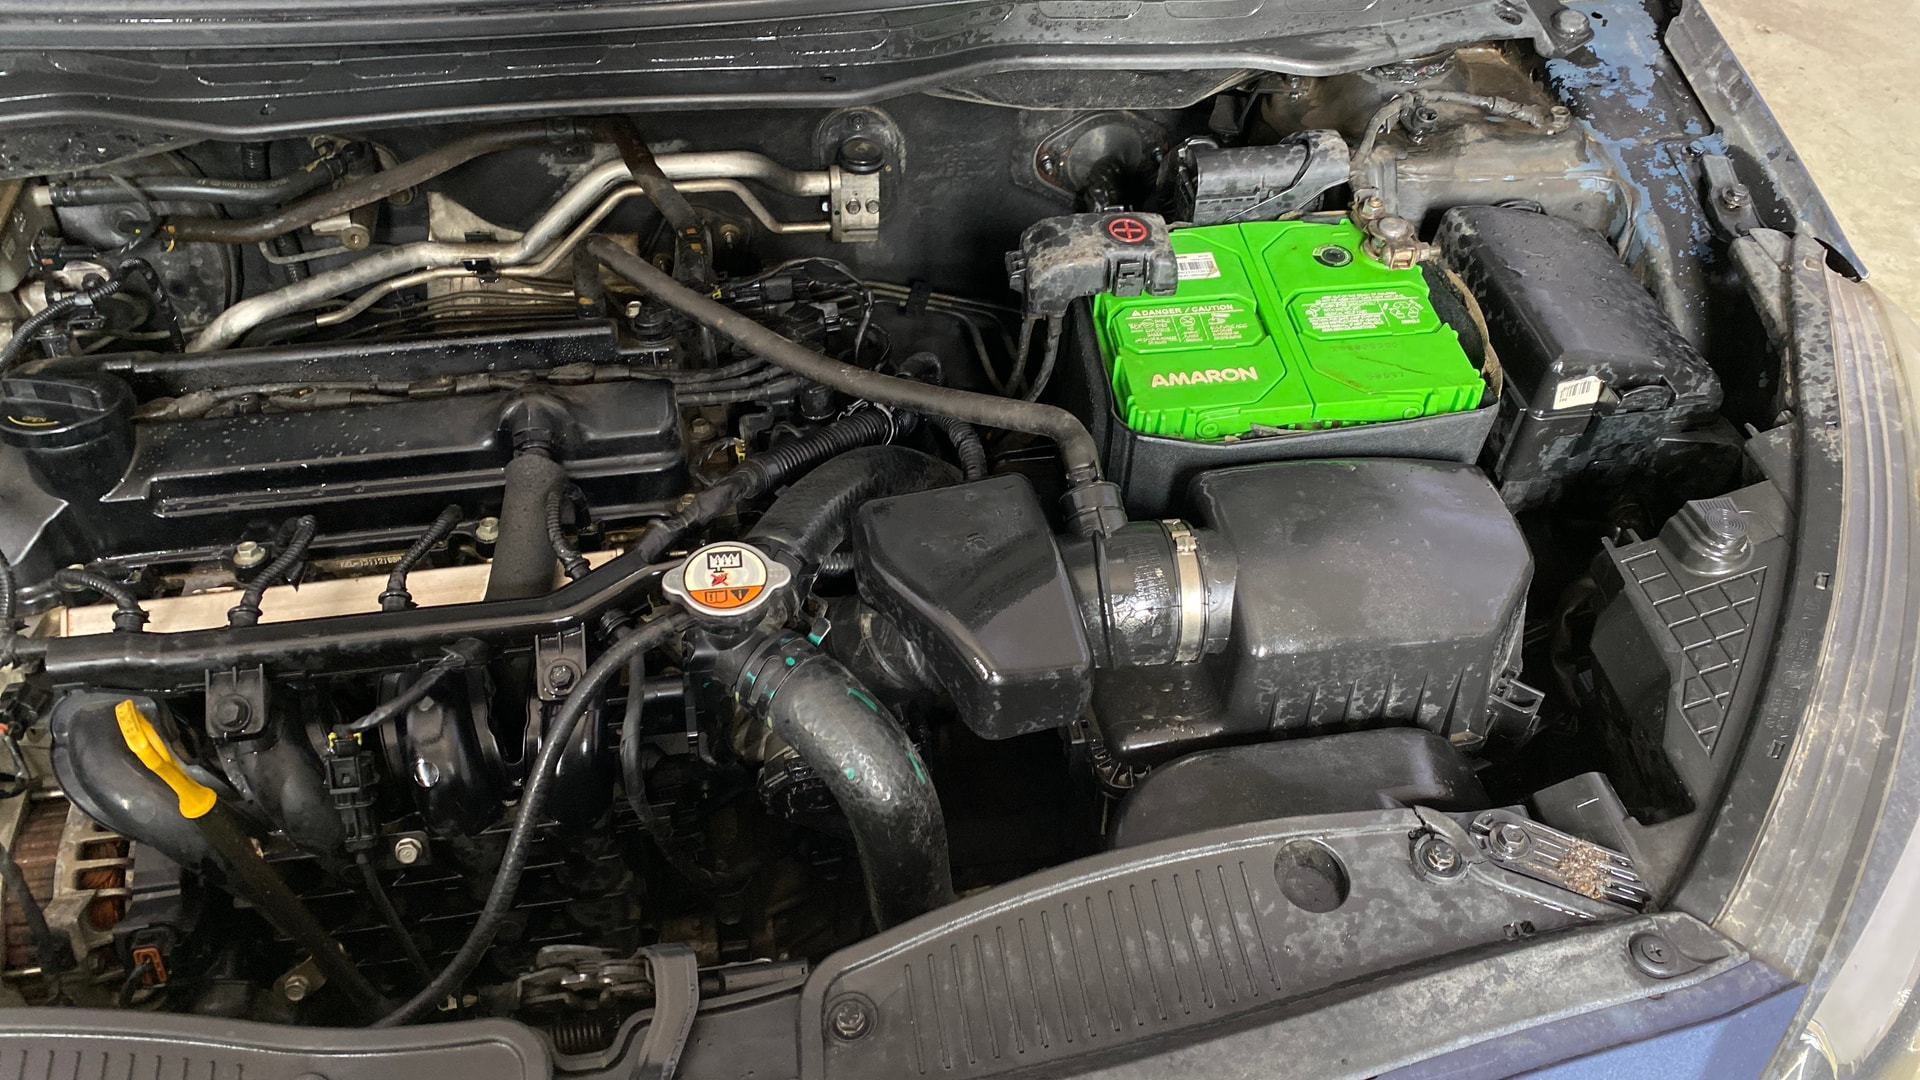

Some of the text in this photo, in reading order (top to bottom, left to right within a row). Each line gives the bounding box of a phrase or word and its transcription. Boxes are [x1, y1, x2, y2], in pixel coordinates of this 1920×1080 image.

[1141, 307, 1182, 316] DANGER
[1191, 304, 1234, 313] CAUTION
[1151, 366, 1258, 388] AMARON
